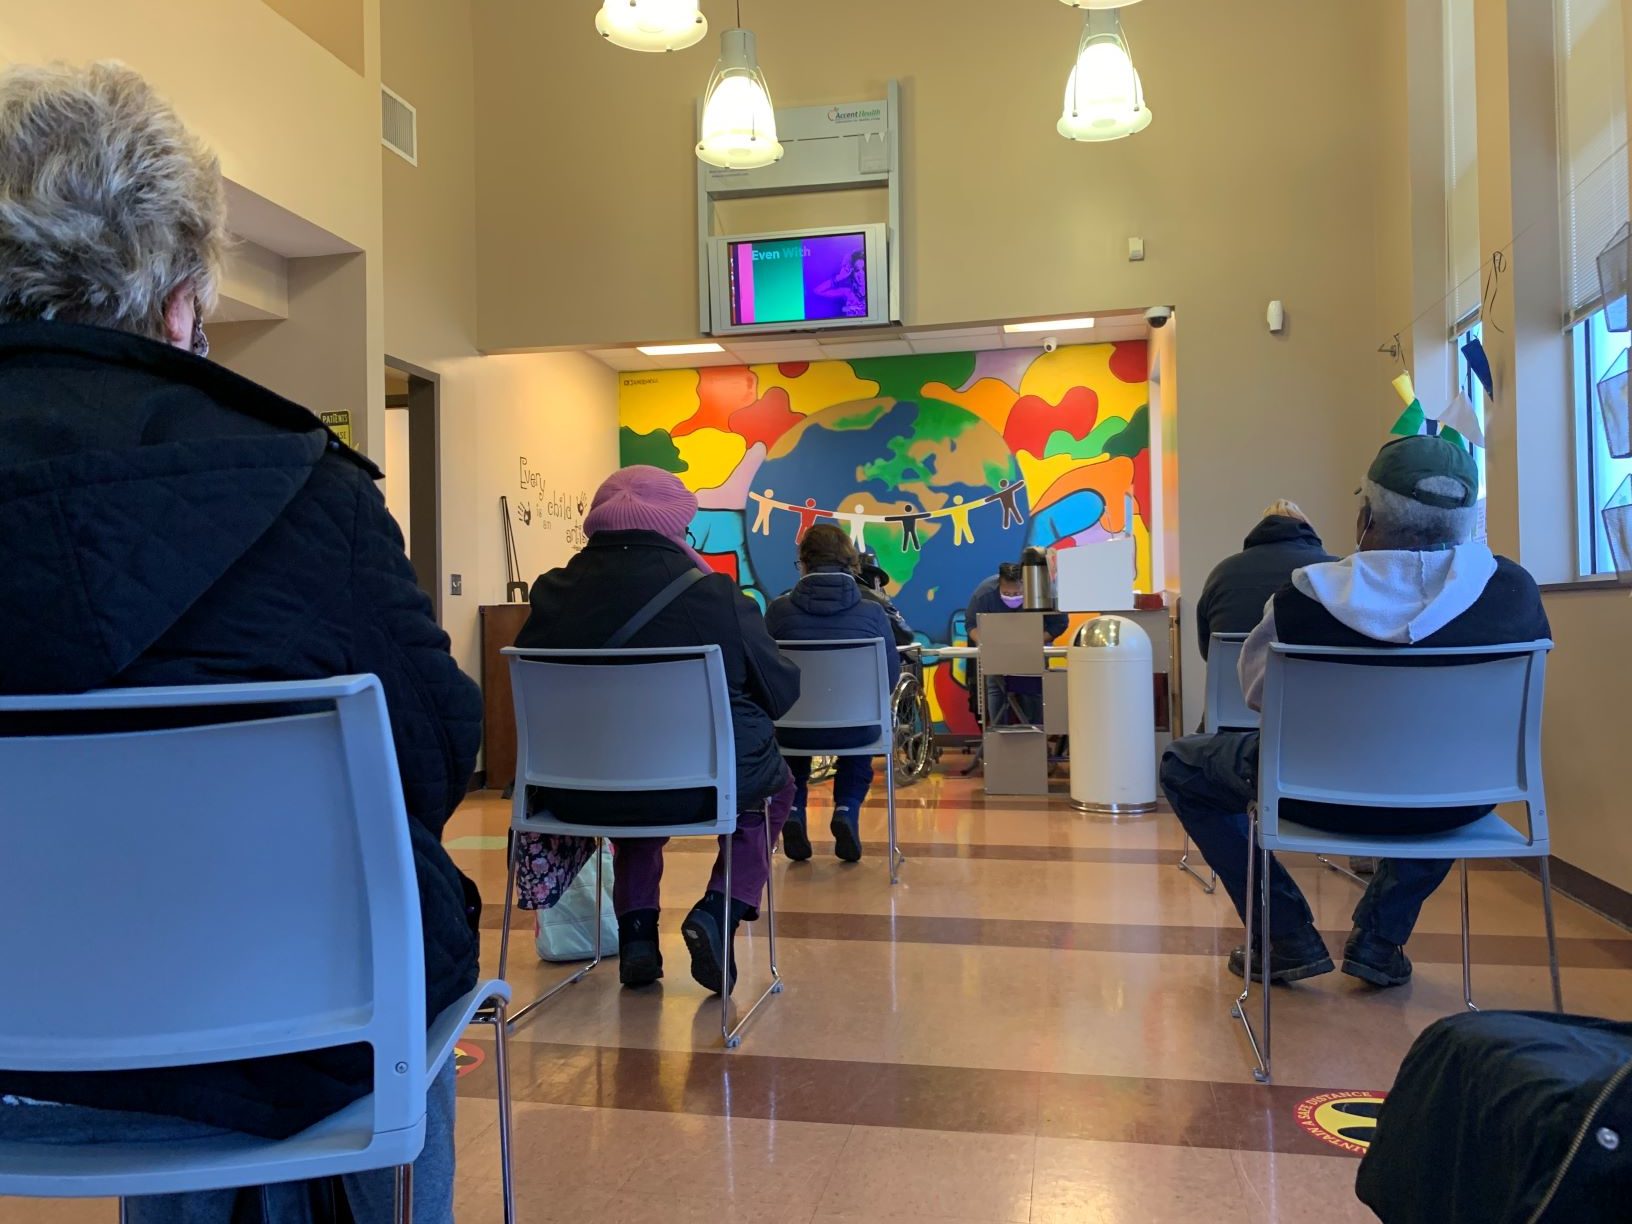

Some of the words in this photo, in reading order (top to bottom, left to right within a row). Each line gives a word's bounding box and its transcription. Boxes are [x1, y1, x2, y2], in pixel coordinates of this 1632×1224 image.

[752, 249, 780, 261] Even
[782, 246, 811, 258] With
[520, 456, 545, 501] Every
[547, 490, 572, 520] child
[566, 520, 587, 544] artis
[1305, 1091, 1373, 1106] DISTANCE
[1297, 1104, 1313, 1120] SAFE
[1307, 1127, 1368, 1154] INTAIN
